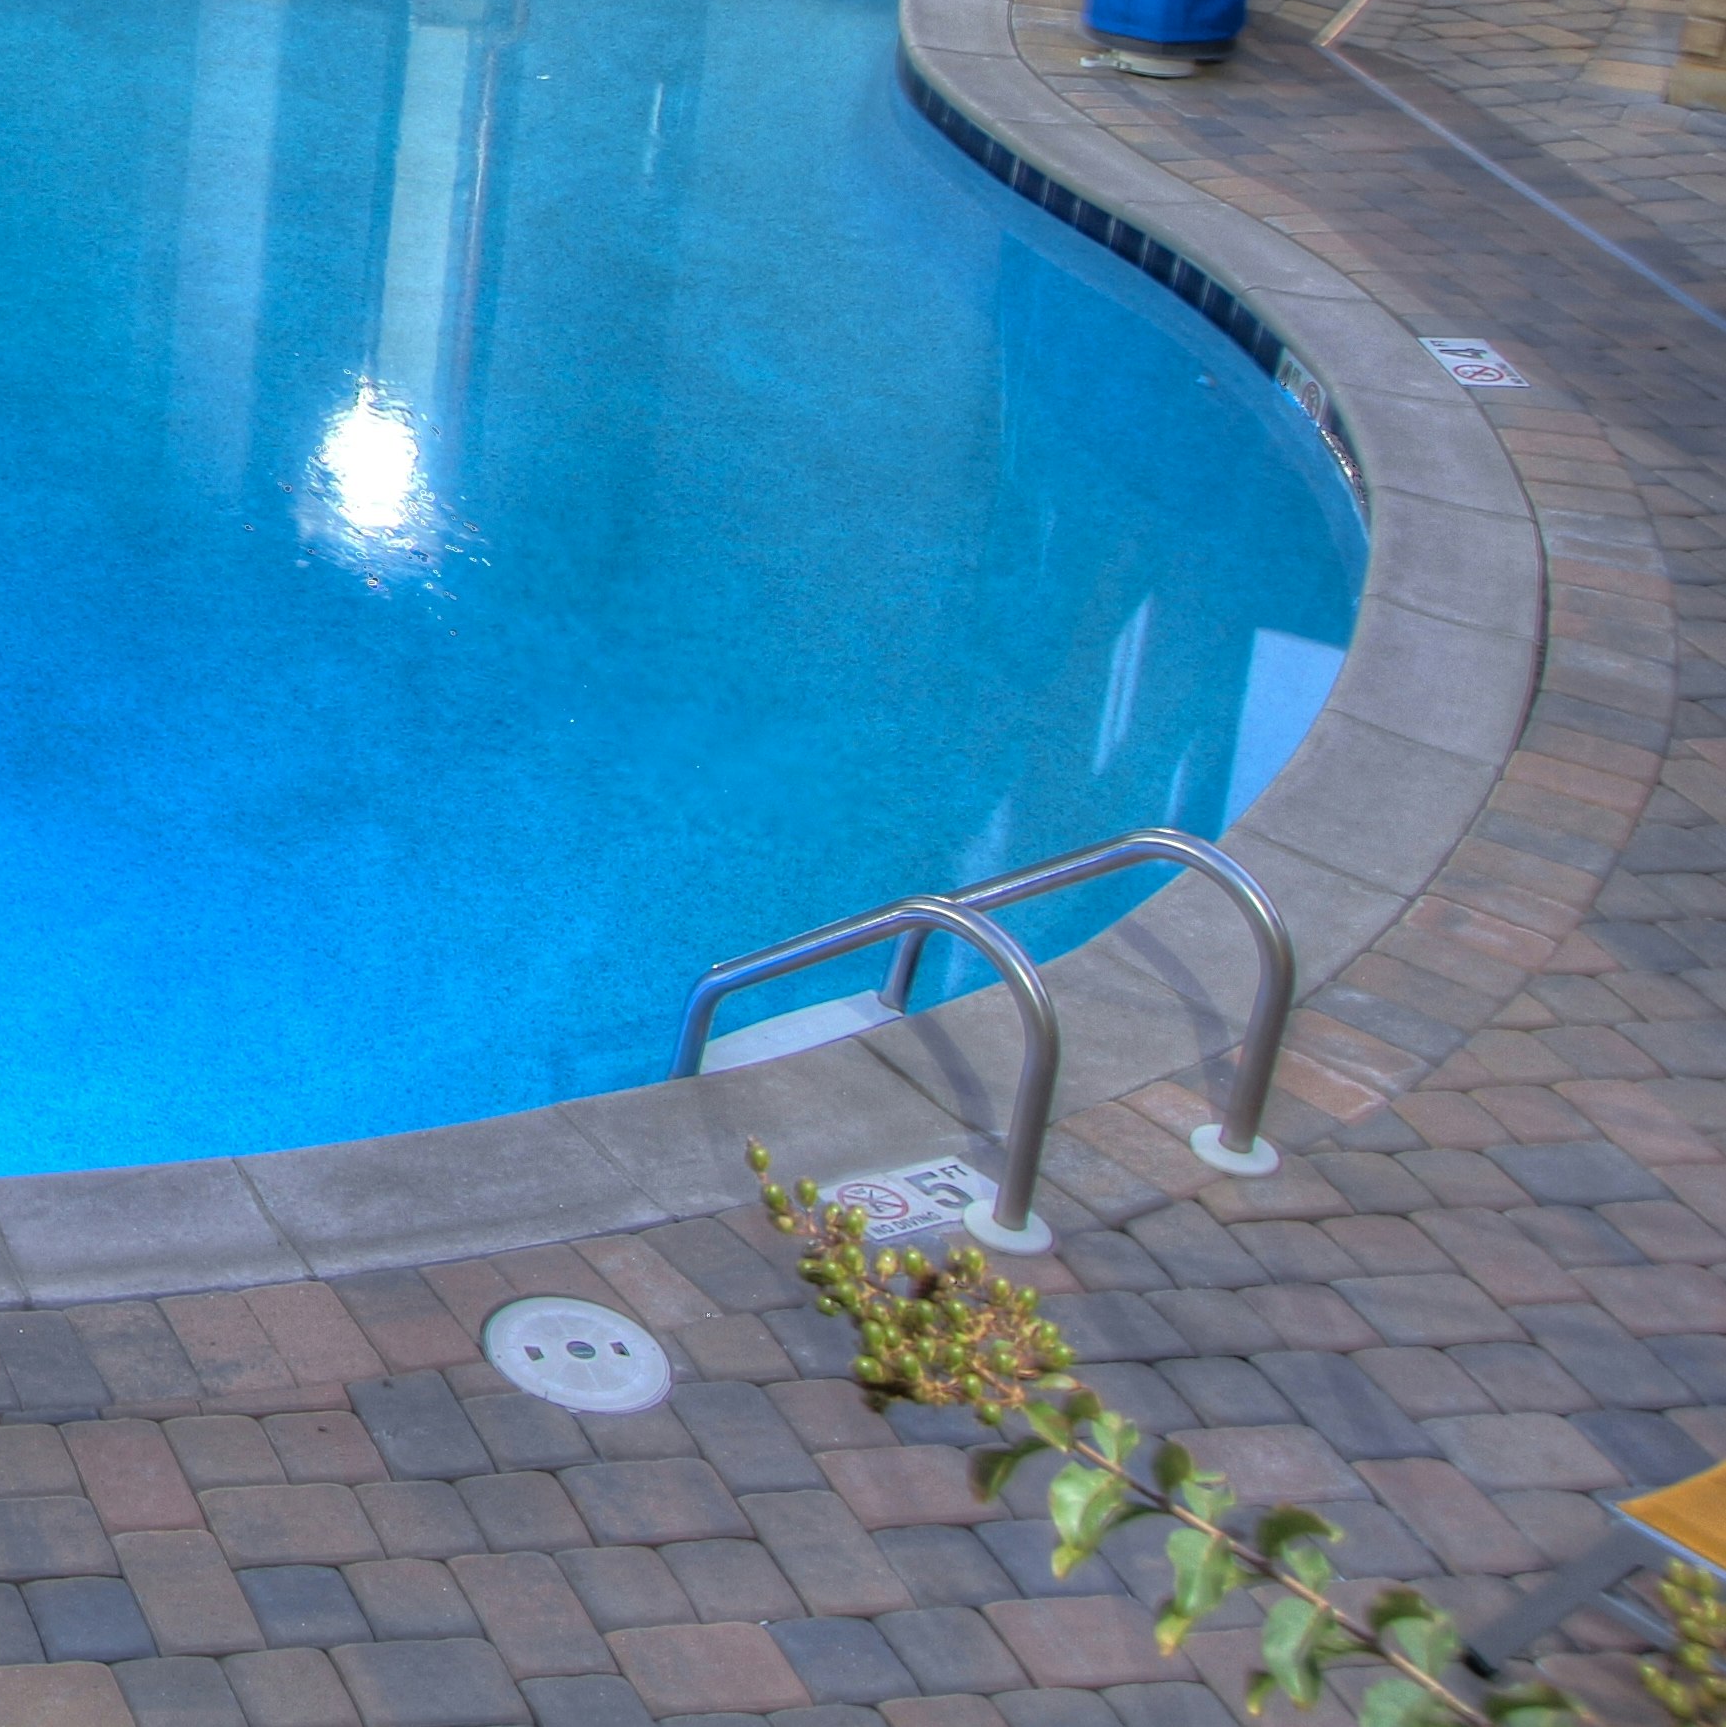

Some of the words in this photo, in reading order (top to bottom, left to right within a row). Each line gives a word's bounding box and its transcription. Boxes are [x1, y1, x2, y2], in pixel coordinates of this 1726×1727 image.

[938, 1164, 969, 1180] FT
[904, 1171, 975, 1210] 5
[868, 1221, 895, 1236] NO
[895, 1210, 944, 1232] DIVING
